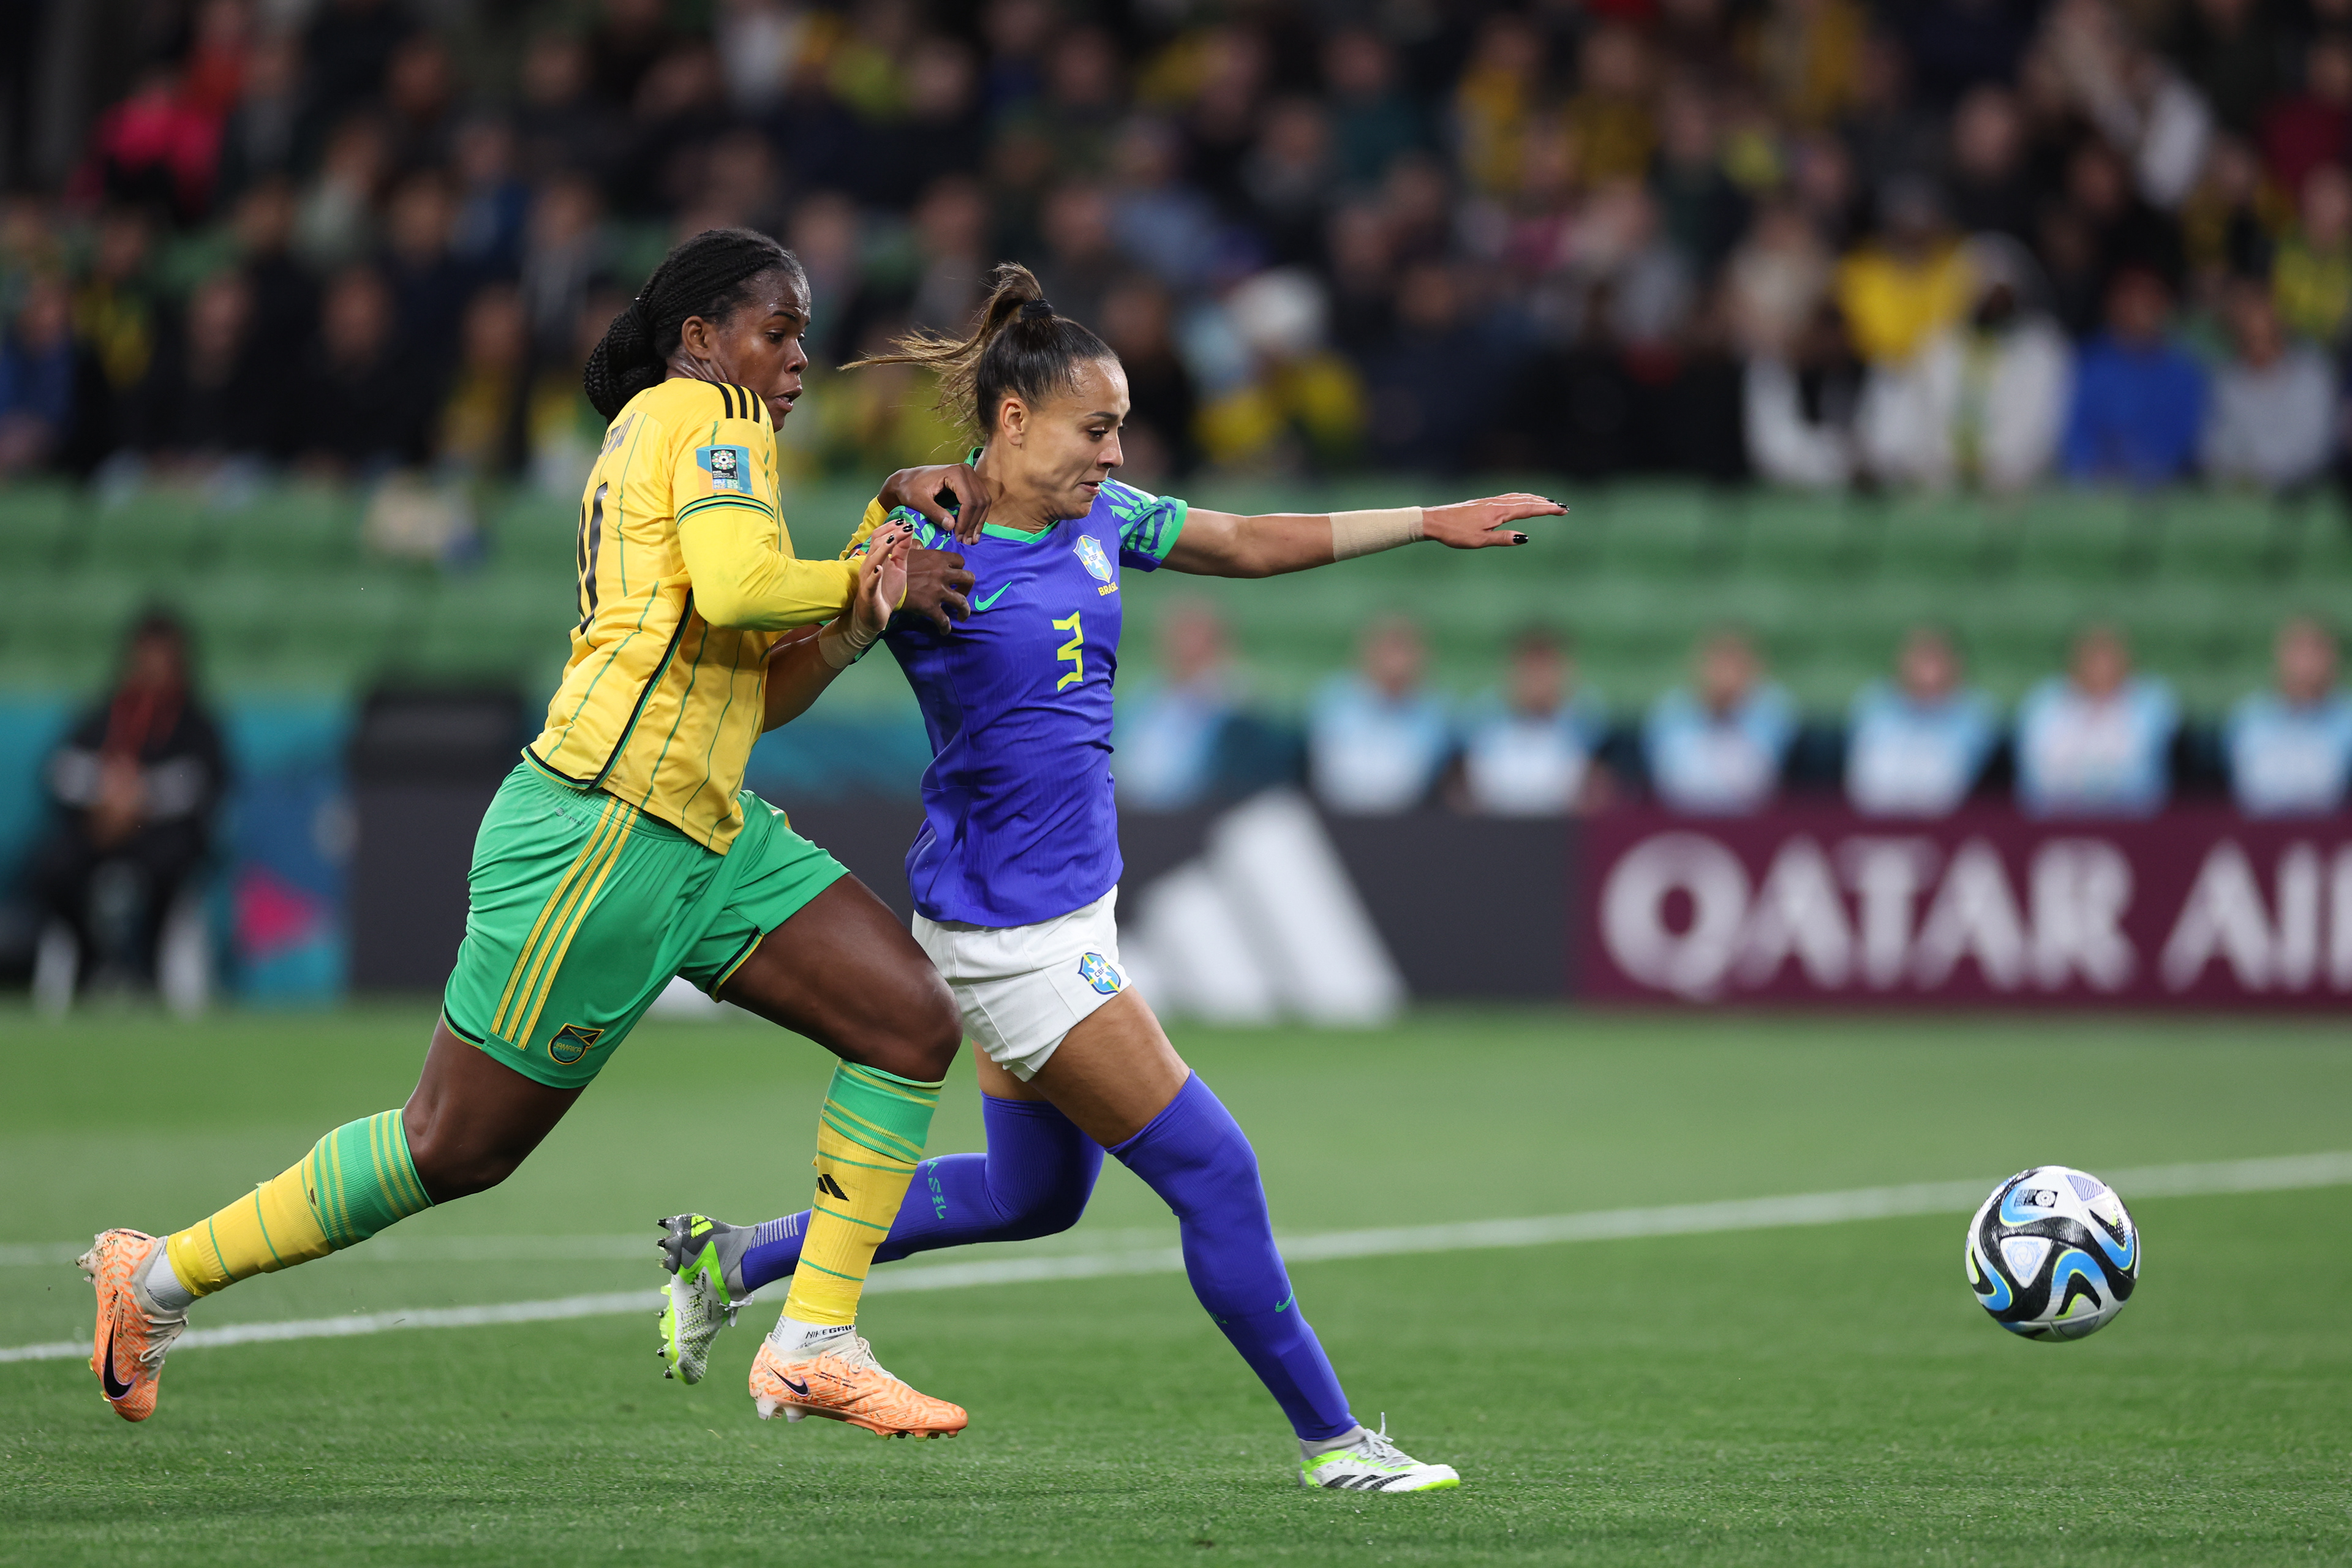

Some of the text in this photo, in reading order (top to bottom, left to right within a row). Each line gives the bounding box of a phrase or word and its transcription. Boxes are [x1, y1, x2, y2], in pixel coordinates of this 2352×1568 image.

[1098, 581, 1118, 596] BRASIL
[1051, 609, 1084, 692] 3
[1600, 832, 2352, 998] QATAR AI
[1095, 967, 1104, 978] CBF
[554, 1042, 582, 1054] JAMAICA
